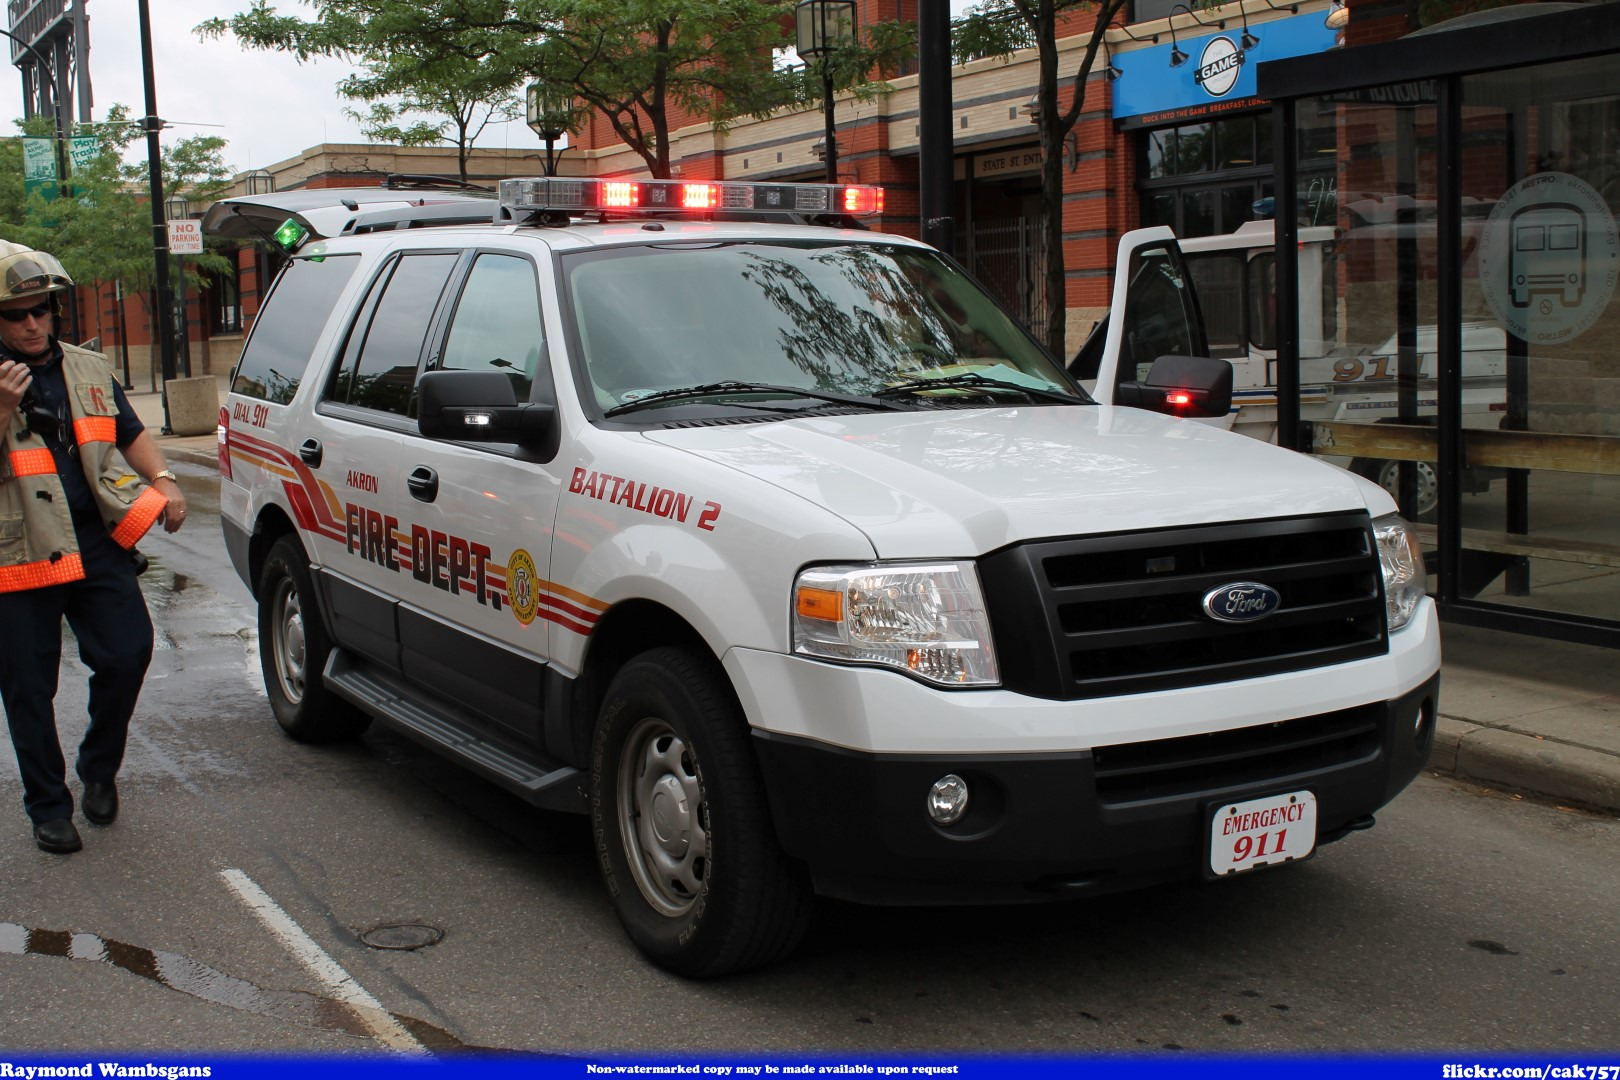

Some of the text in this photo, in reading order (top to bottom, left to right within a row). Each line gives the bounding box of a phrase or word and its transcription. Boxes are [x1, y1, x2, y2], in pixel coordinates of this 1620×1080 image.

[1201, 53, 1239, 79] GAME
[1142, 114, 1159, 123] DUCK
[1160, 111, 1175, 121] INTO
[1176, 109, 1188, 119] THE
[1188, 106, 1207, 116] GAME
[1209, 101, 1248, 113] BREAKFAST,
[73, 138, 96, 149] Play
[983, 158, 1006, 171] STATE
[1520, 175, 1556, 192] METRO
[172, 233, 200, 242] PARKING
[176, 224, 194, 233] NO
[173, 243, 185, 251] ANY
[233, 402, 269, 428] DIAL 911
[346, 470, 379, 493] AKRON
[568, 467, 722, 531] BATTALION 2
[345, 502, 502, 611] FIRE DEPT.
[1225, 588, 1267, 614] Ford
[1222, 803, 1306, 836] EMERGENCY
[1232, 828, 1288, 862] 911
